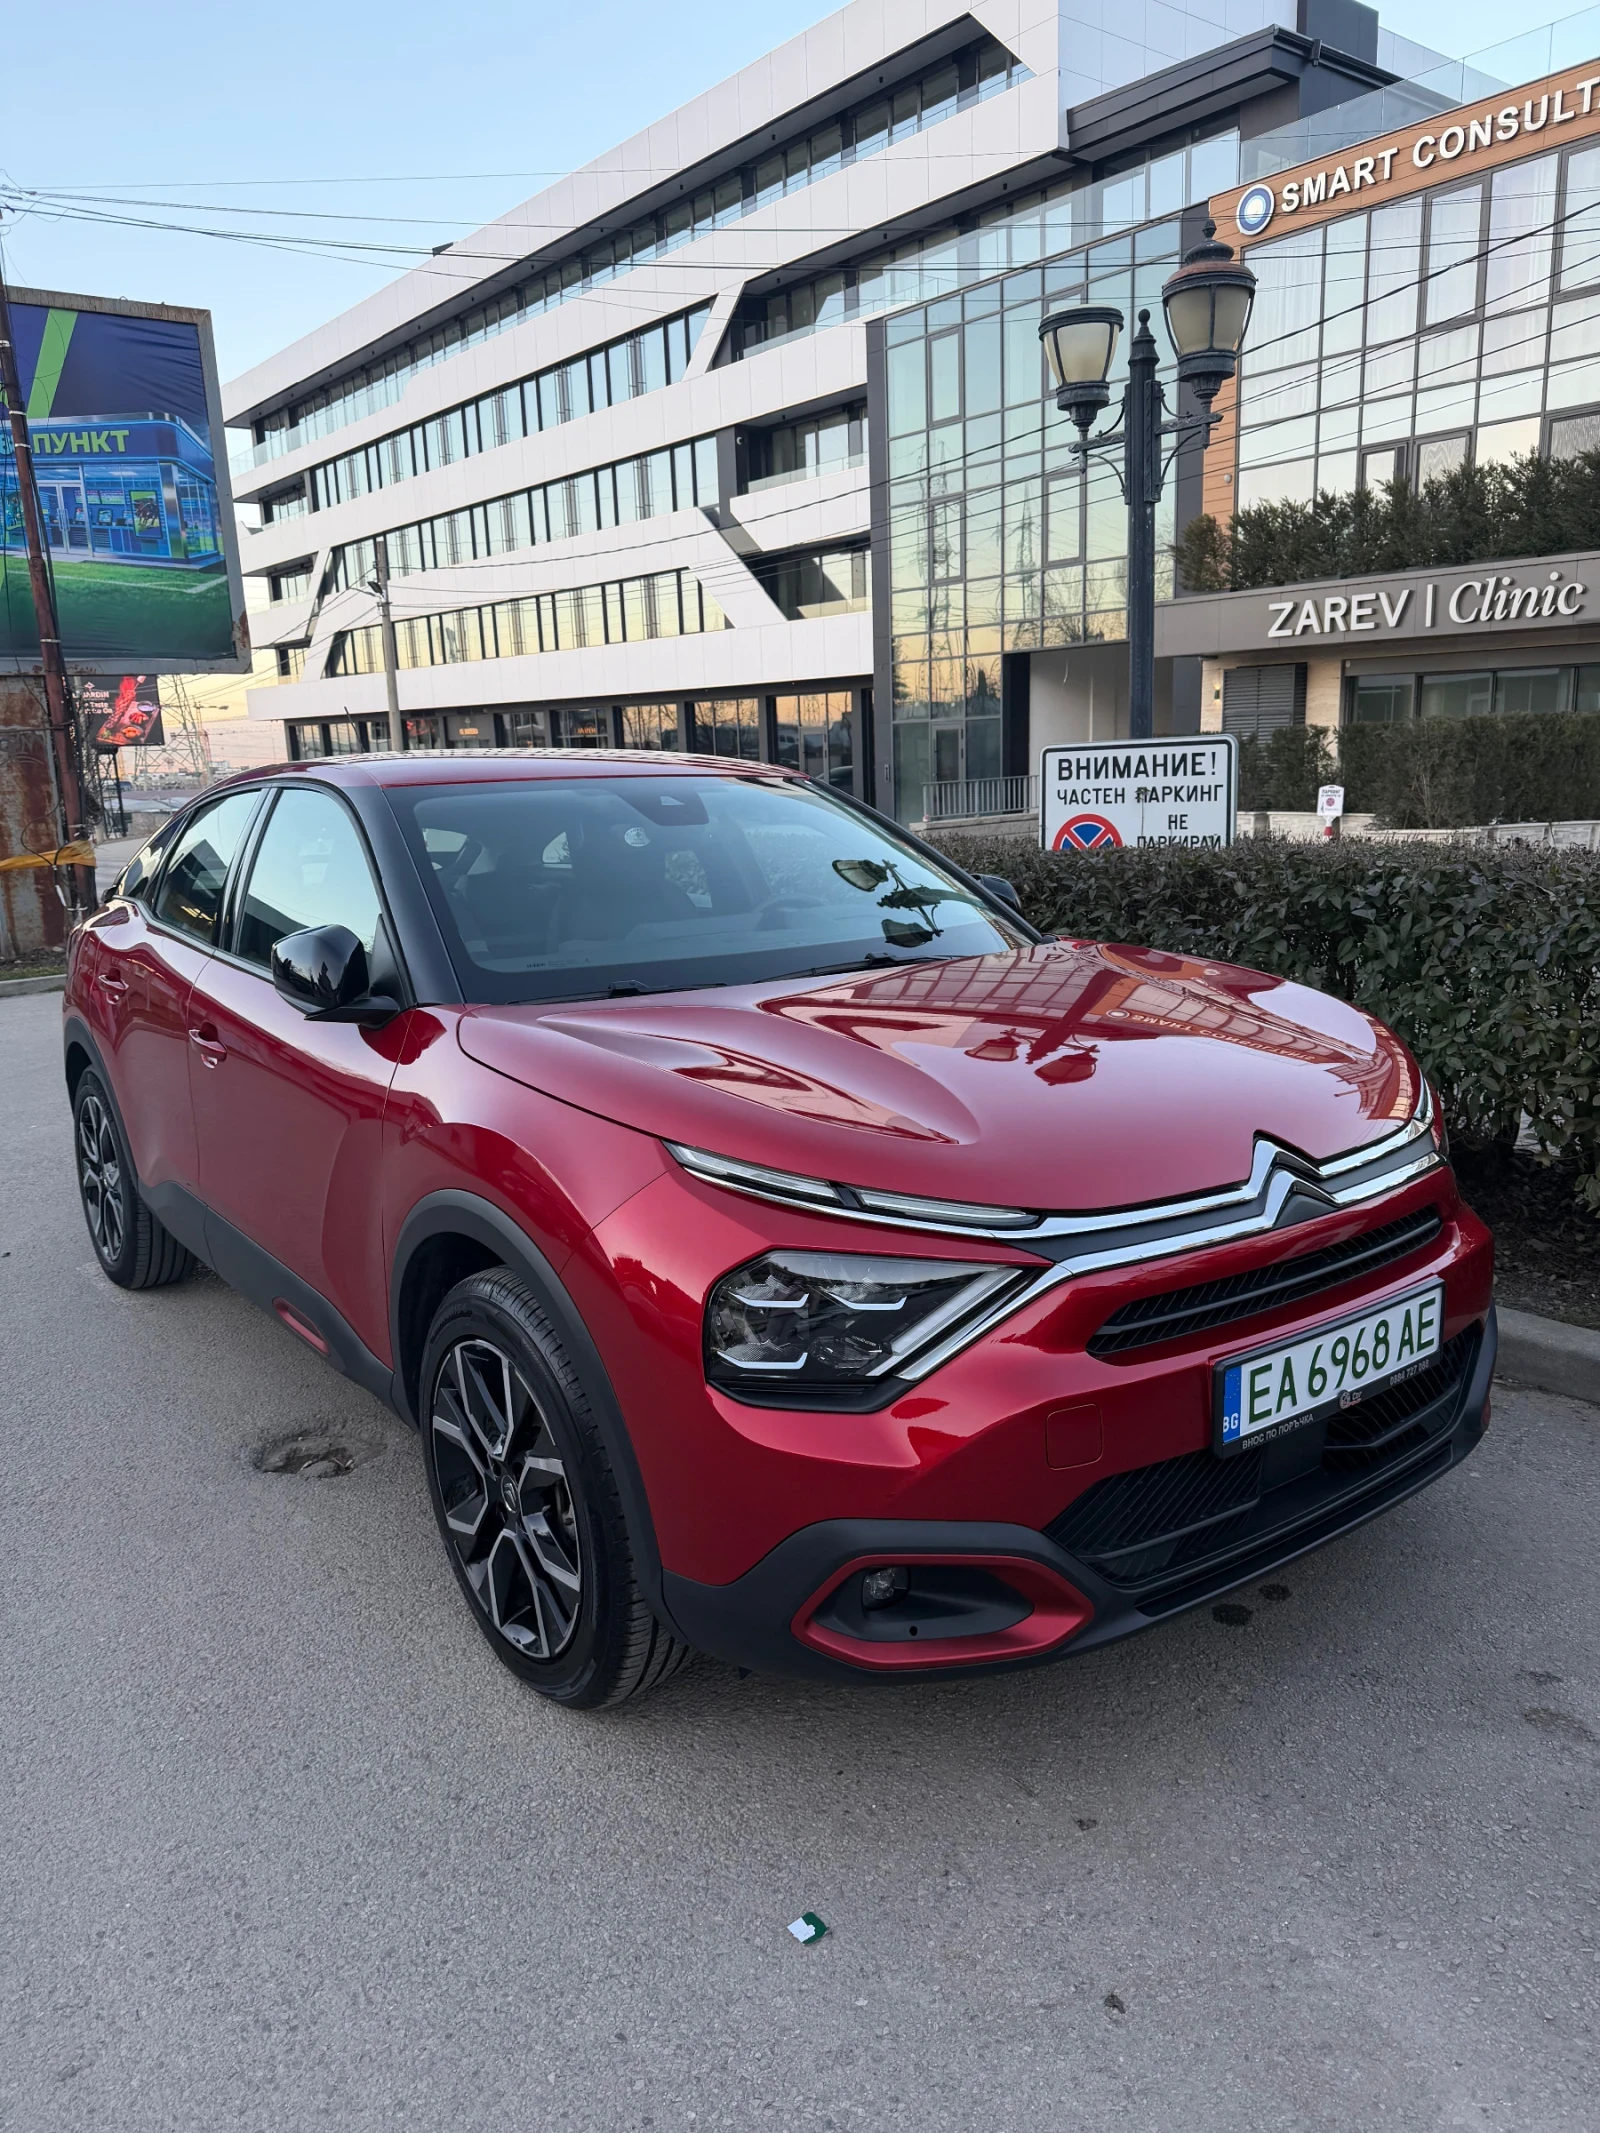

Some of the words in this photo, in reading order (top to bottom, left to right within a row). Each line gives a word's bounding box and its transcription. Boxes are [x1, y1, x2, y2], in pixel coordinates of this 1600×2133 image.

[1280, 146, 1399, 213] SMART
[1411, 75, 1600, 168] CONSULT
[32, 429, 130, 454] ПУНКТ
[1267, 588, 1413, 638] ZAREV
[1448, 571, 1586, 625] Clinic
[1058, 751, 1217, 781] ВНИМАНИЕ!
[1057, 787, 1126, 806] ЧАСТЕН
[1167, 814, 1189, 830] НЕ
[1248, 1356, 1298, 1425] EA
[1307, 1319, 1390, 1398] 6968
[1396, 1297, 1436, 1362] AE
[1223, 1412, 1239, 1434] BG
[1242, 1433, 1265, 1450] ВНОС
[1265, 1428, 1278, 1440] ПО
[1278, 1413, 1314, 1435] ПОРЪЧКА
